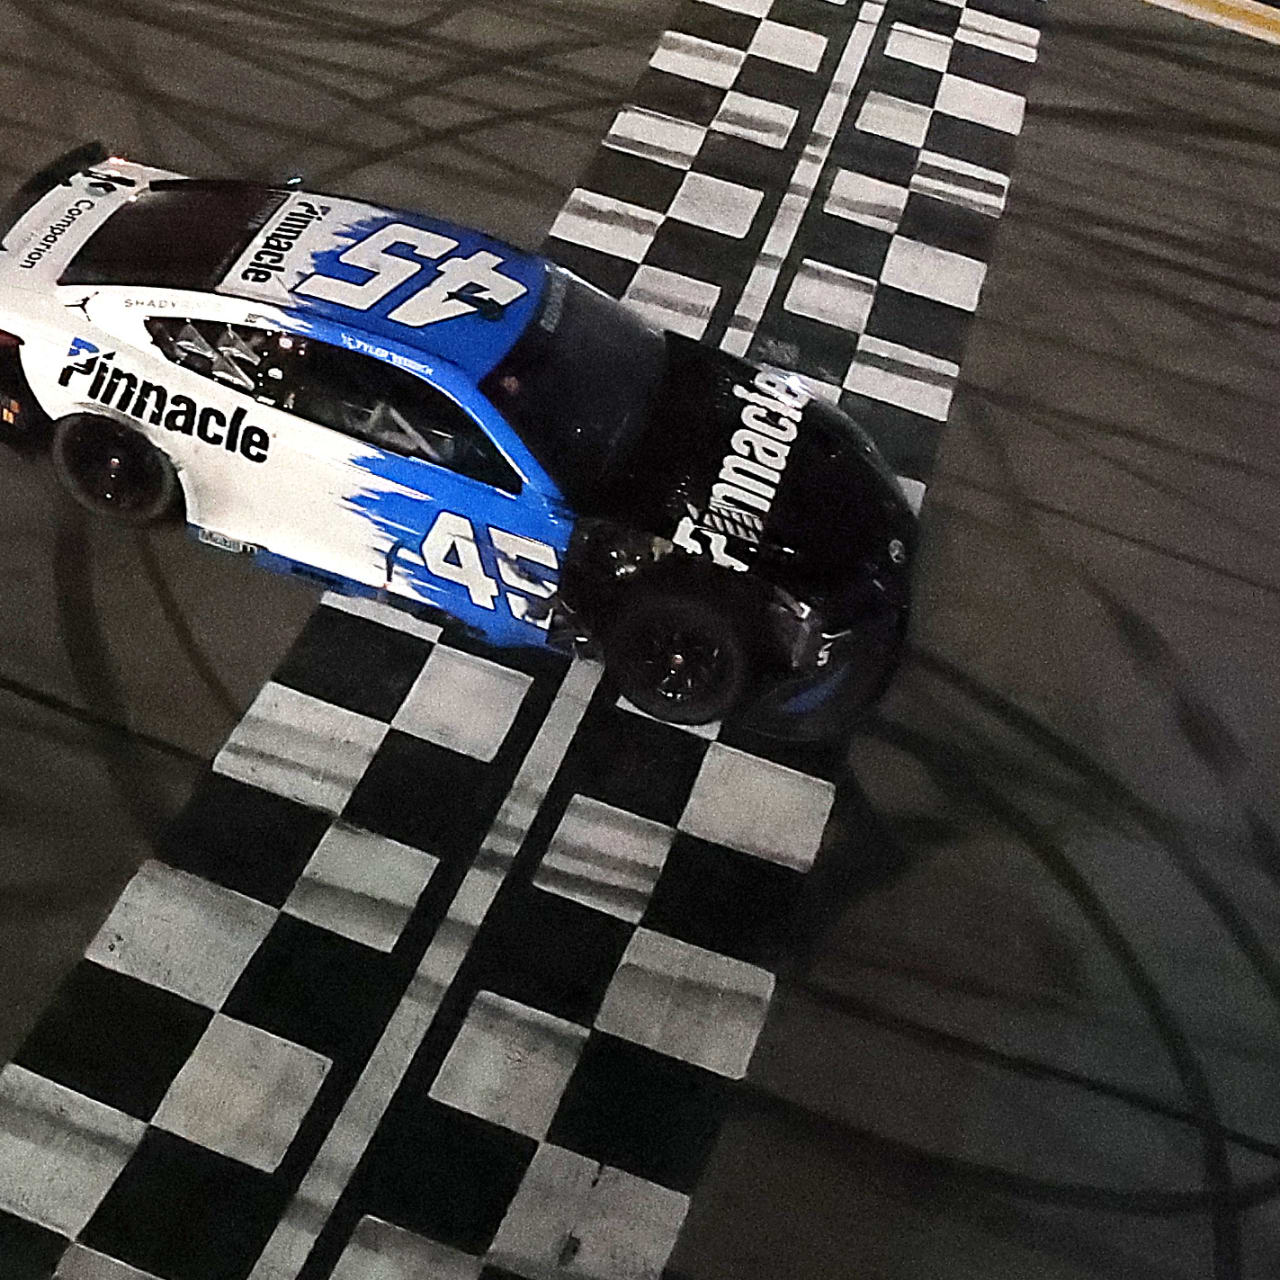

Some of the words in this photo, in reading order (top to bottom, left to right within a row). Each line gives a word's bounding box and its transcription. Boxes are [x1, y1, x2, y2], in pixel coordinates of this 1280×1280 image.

[20, 199, 96, 270] Comparion
[242, 200, 330, 284] Pinnacle
[293, 222, 529, 327] 45
[58, 336, 271, 464] Pinnacle
[672, 368, 810, 572] Pinnacle
